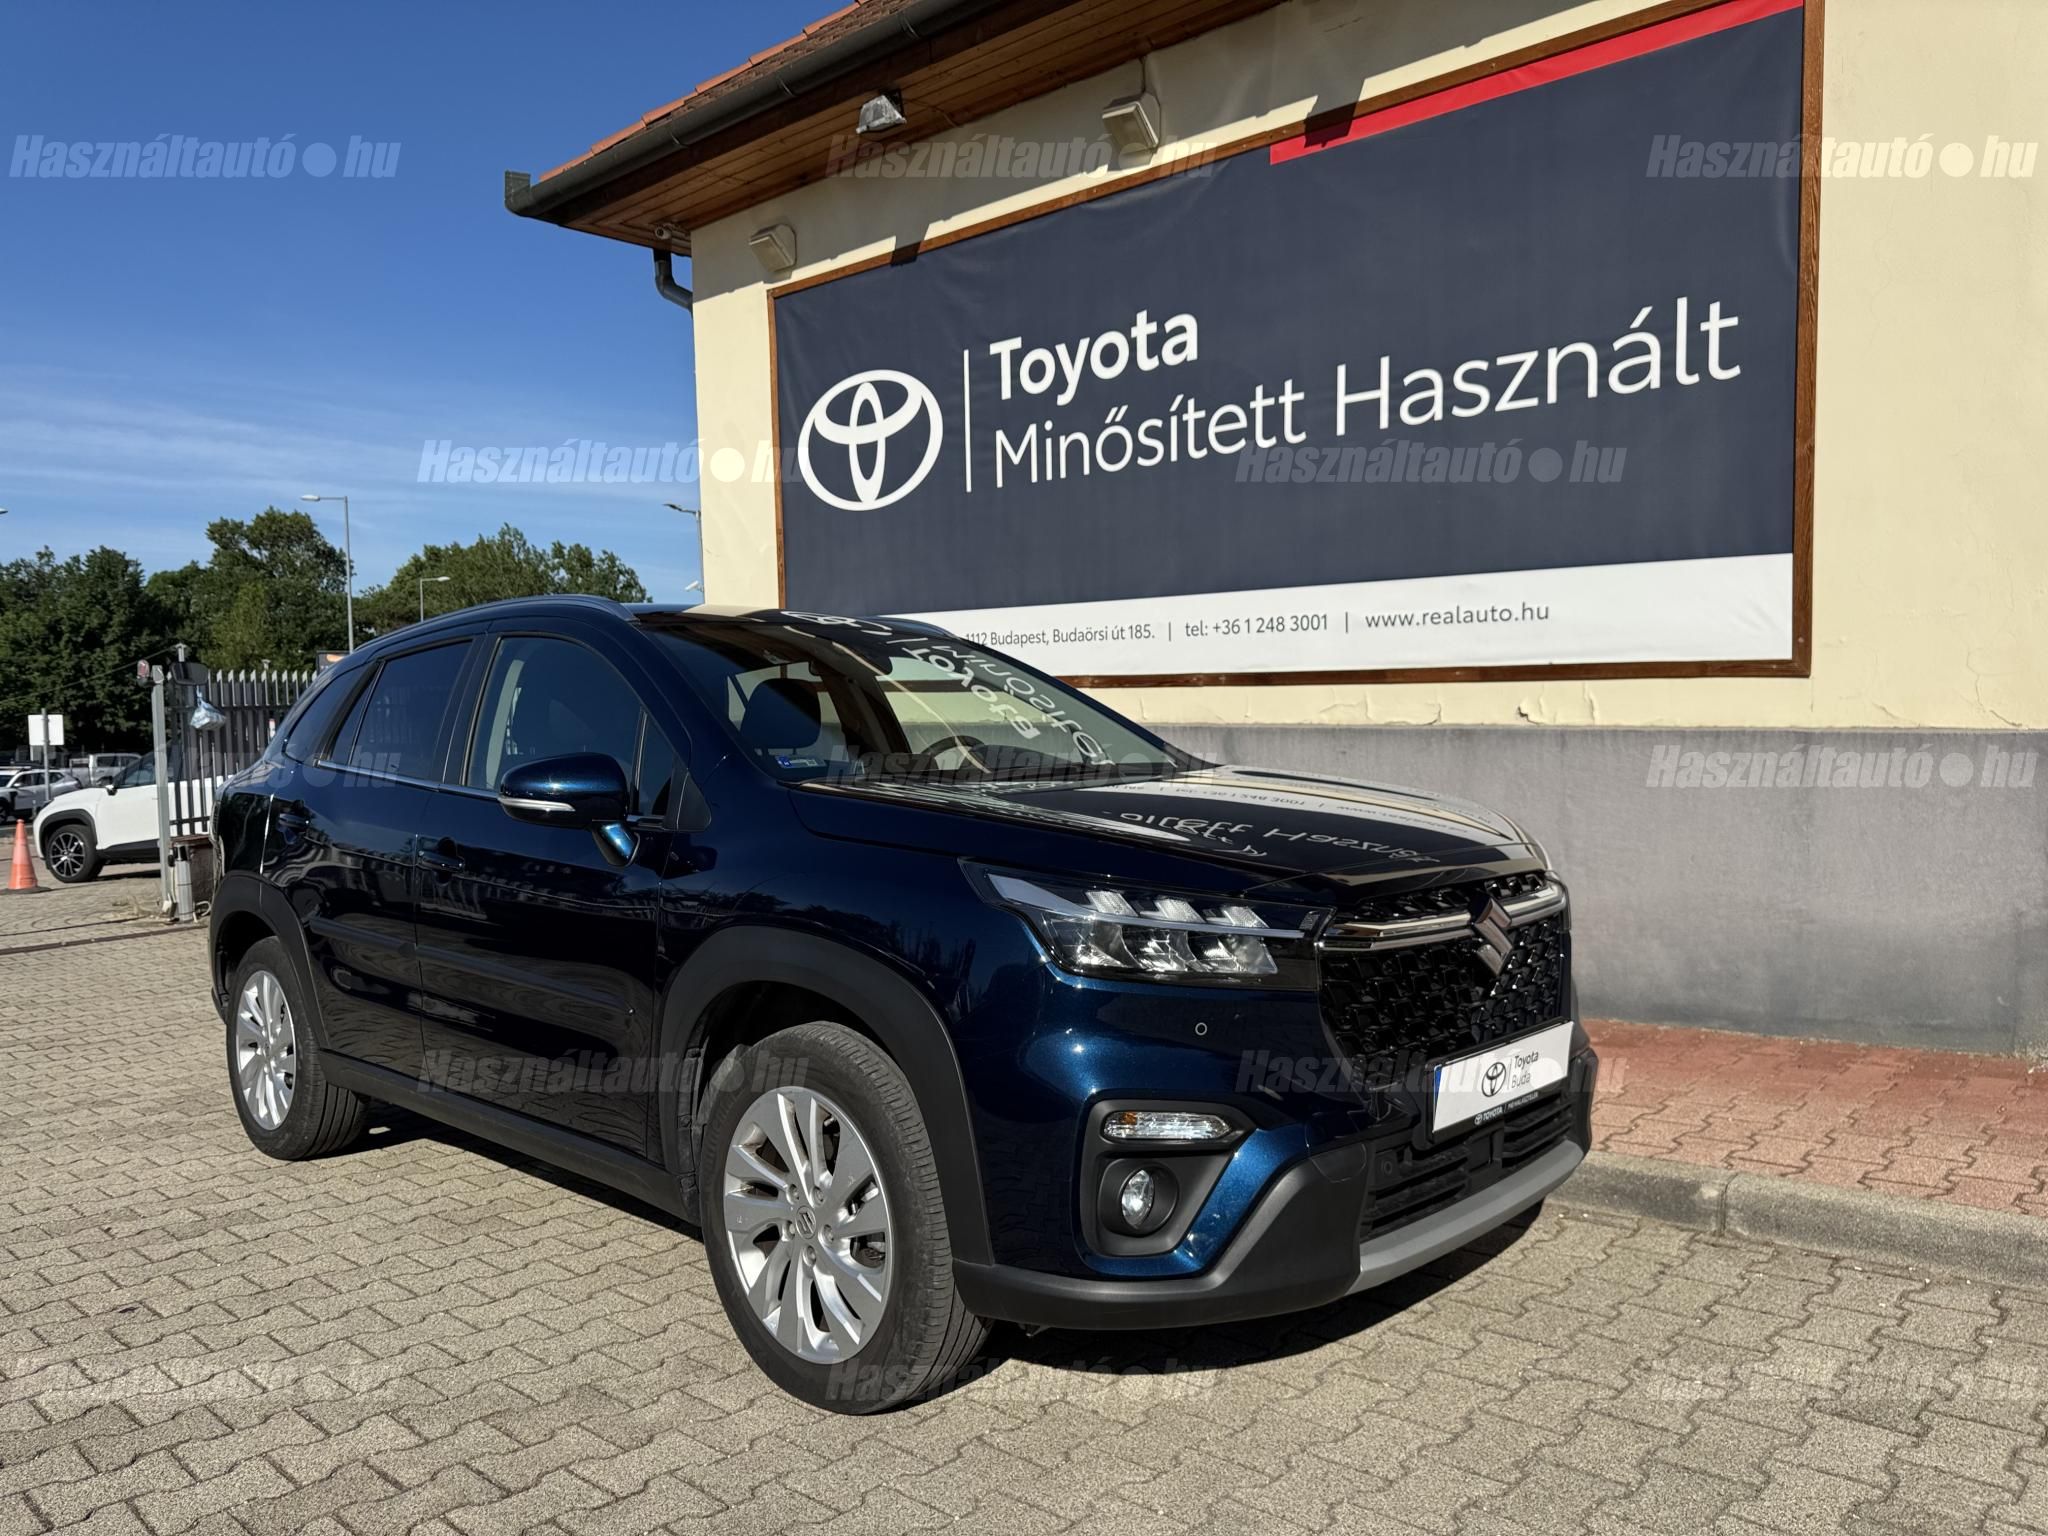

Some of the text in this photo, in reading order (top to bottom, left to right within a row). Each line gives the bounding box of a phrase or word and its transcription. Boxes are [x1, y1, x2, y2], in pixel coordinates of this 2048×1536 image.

[989, 308, 1200, 405] Toyota
[996, 296, 1741, 489] Minősített Használt
[990, 630, 1049, 648] Budapest,
[1053, 626, 1108, 643] Budaörsi
[1112, 624, 1126, 640] út
[1128, 623, 1156, 640] 185.
[1185, 621, 1208, 638] tel:
[1212, 618, 1240, 636] +36
[1256, 616, 1285, 633] 248
[1290, 614, 1328, 632] 3001
[1364, 602, 1550, 628] www.realauto.hu
[1511, 1070, 1531, 1088] Buda
[1514, 1050, 1539, 1070] Toyota
